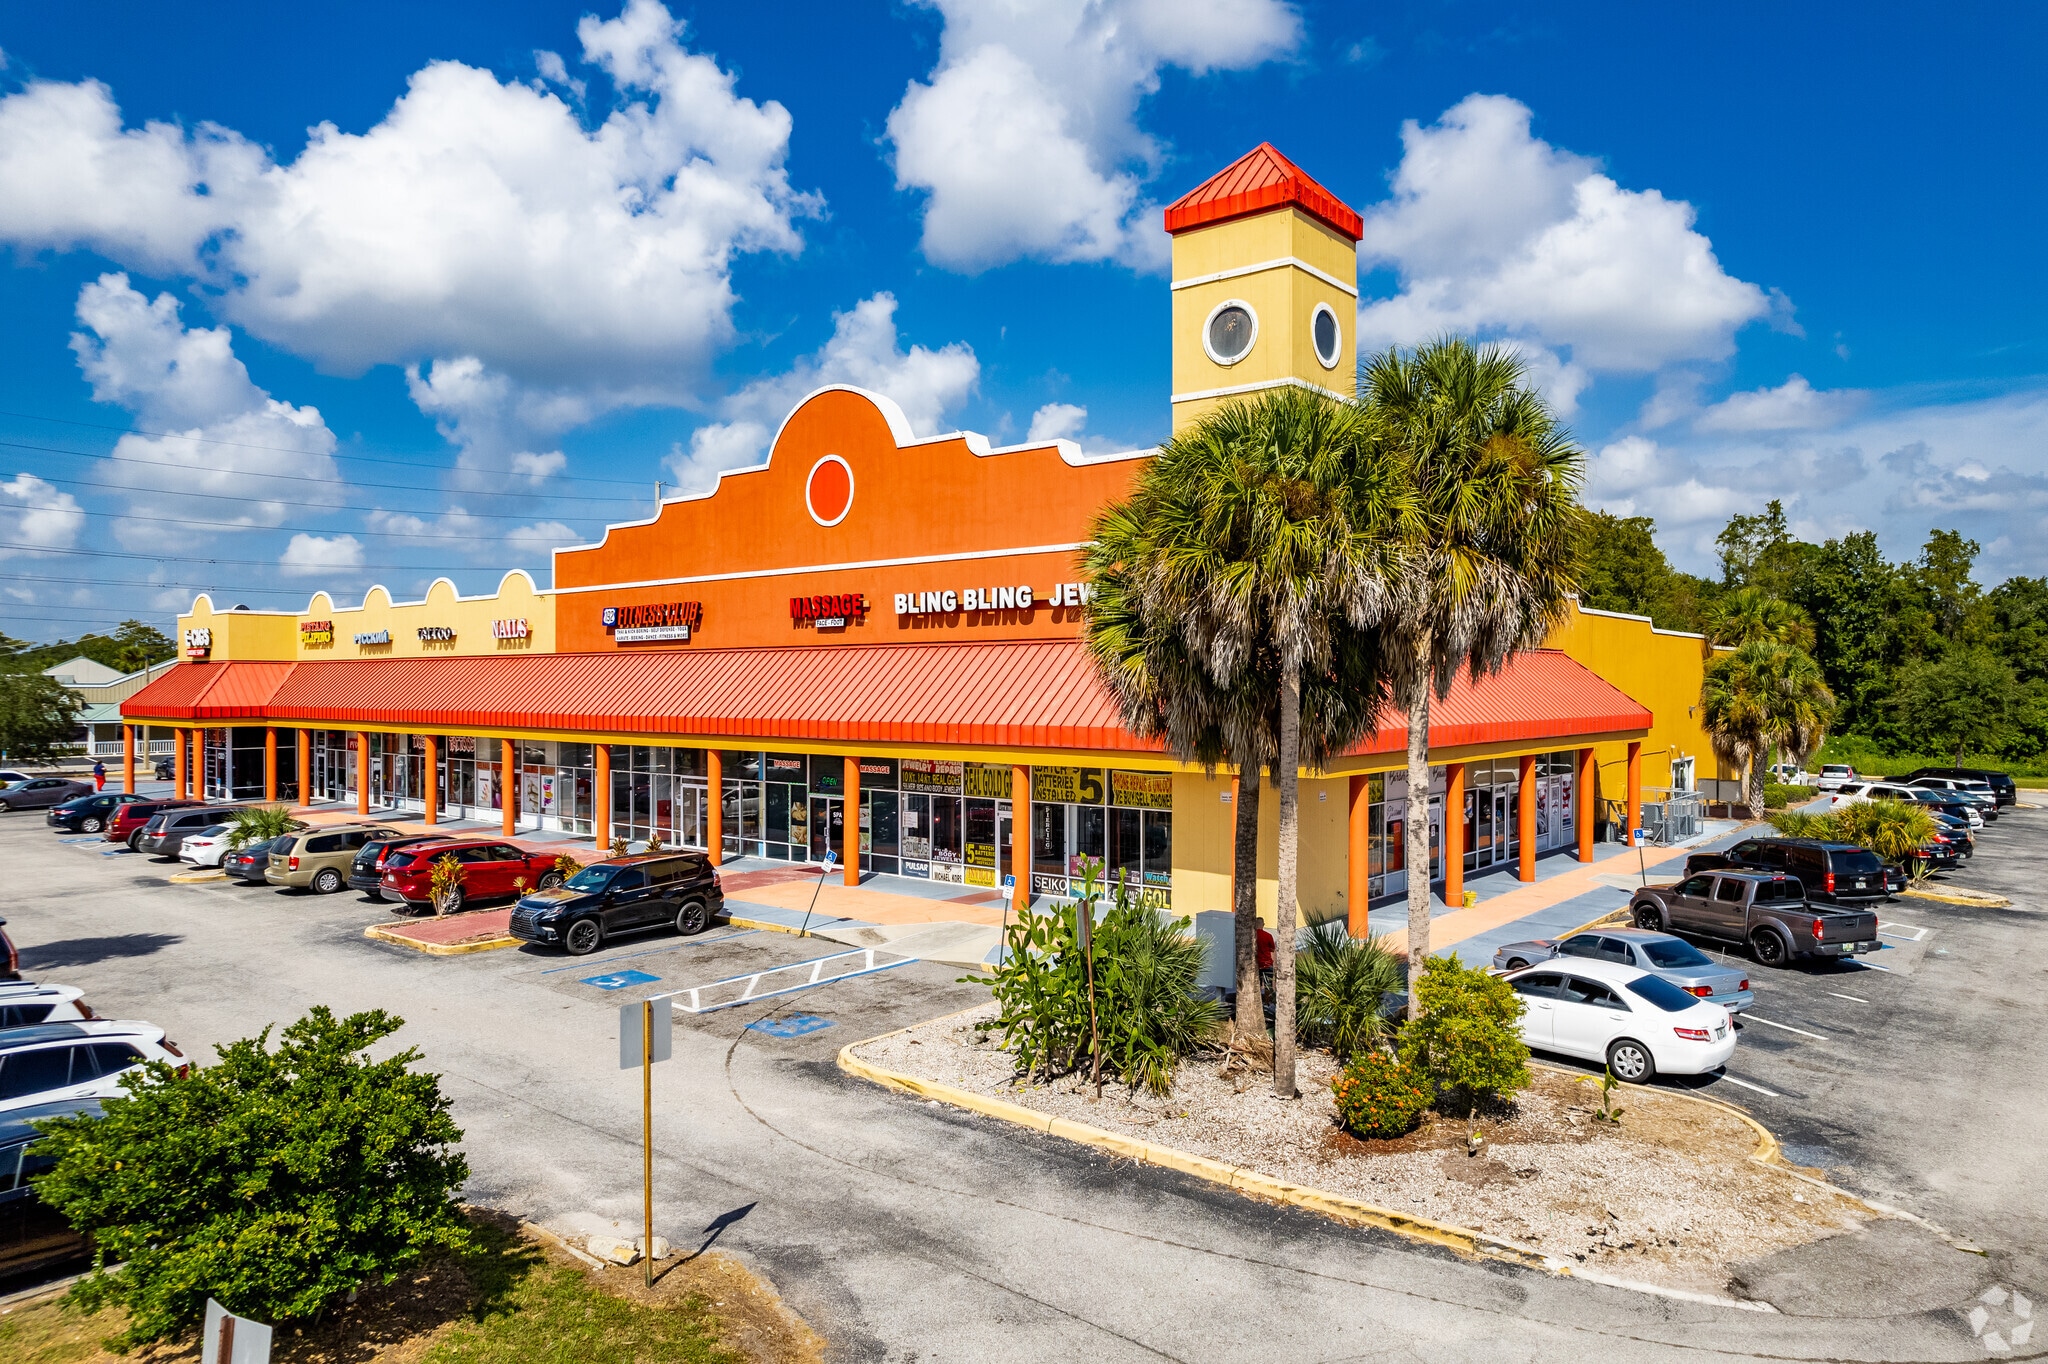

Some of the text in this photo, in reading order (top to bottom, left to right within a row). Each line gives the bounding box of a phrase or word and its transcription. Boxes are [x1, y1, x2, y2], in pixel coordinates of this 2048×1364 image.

[790, 594, 862, 618] MASSAGE
[894, 590, 957, 614] BLING
[963, 586, 1032, 611] BLING
[618, 602, 699, 625] FITNESS CLUB
[492, 618, 527, 638] NAILS
[774, 760, 800, 768] MASSAGE
[860, 765, 890, 774] MASSAGE
[822, 776, 838, 786] OPEN
[983, 769, 1002, 796] GOLD
[905, 862, 929, 871] PULSAR
[1034, 876, 1067, 891] SEIKO
[1145, 873, 1169, 882] Watch
